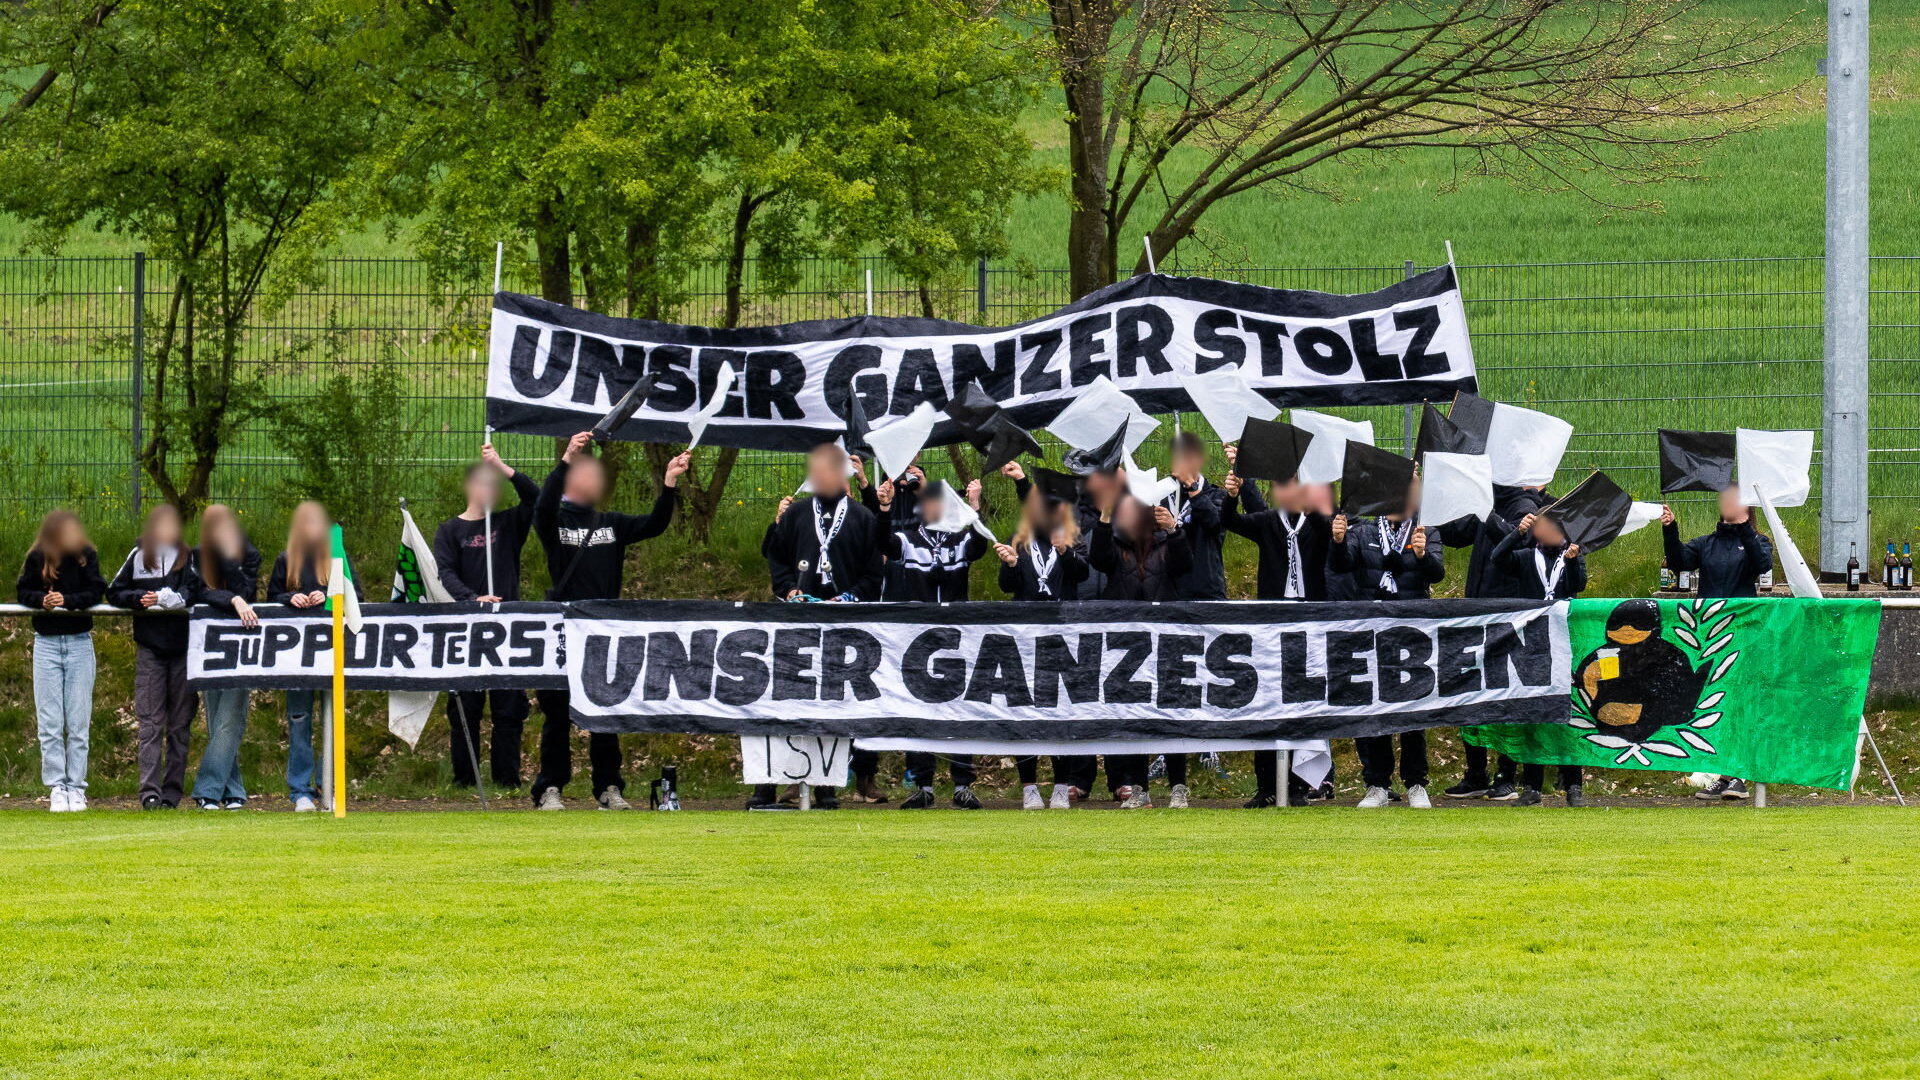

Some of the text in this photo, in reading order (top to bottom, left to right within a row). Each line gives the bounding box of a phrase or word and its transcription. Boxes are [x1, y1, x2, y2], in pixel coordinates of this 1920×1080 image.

[510, 304, 1452, 422] UNSER GANZER STOLZ
[580, 628, 882, 706] UNSER
[902, 627, 1258, 710] GANZES
[1280, 615, 1551, 706] LEBEN
